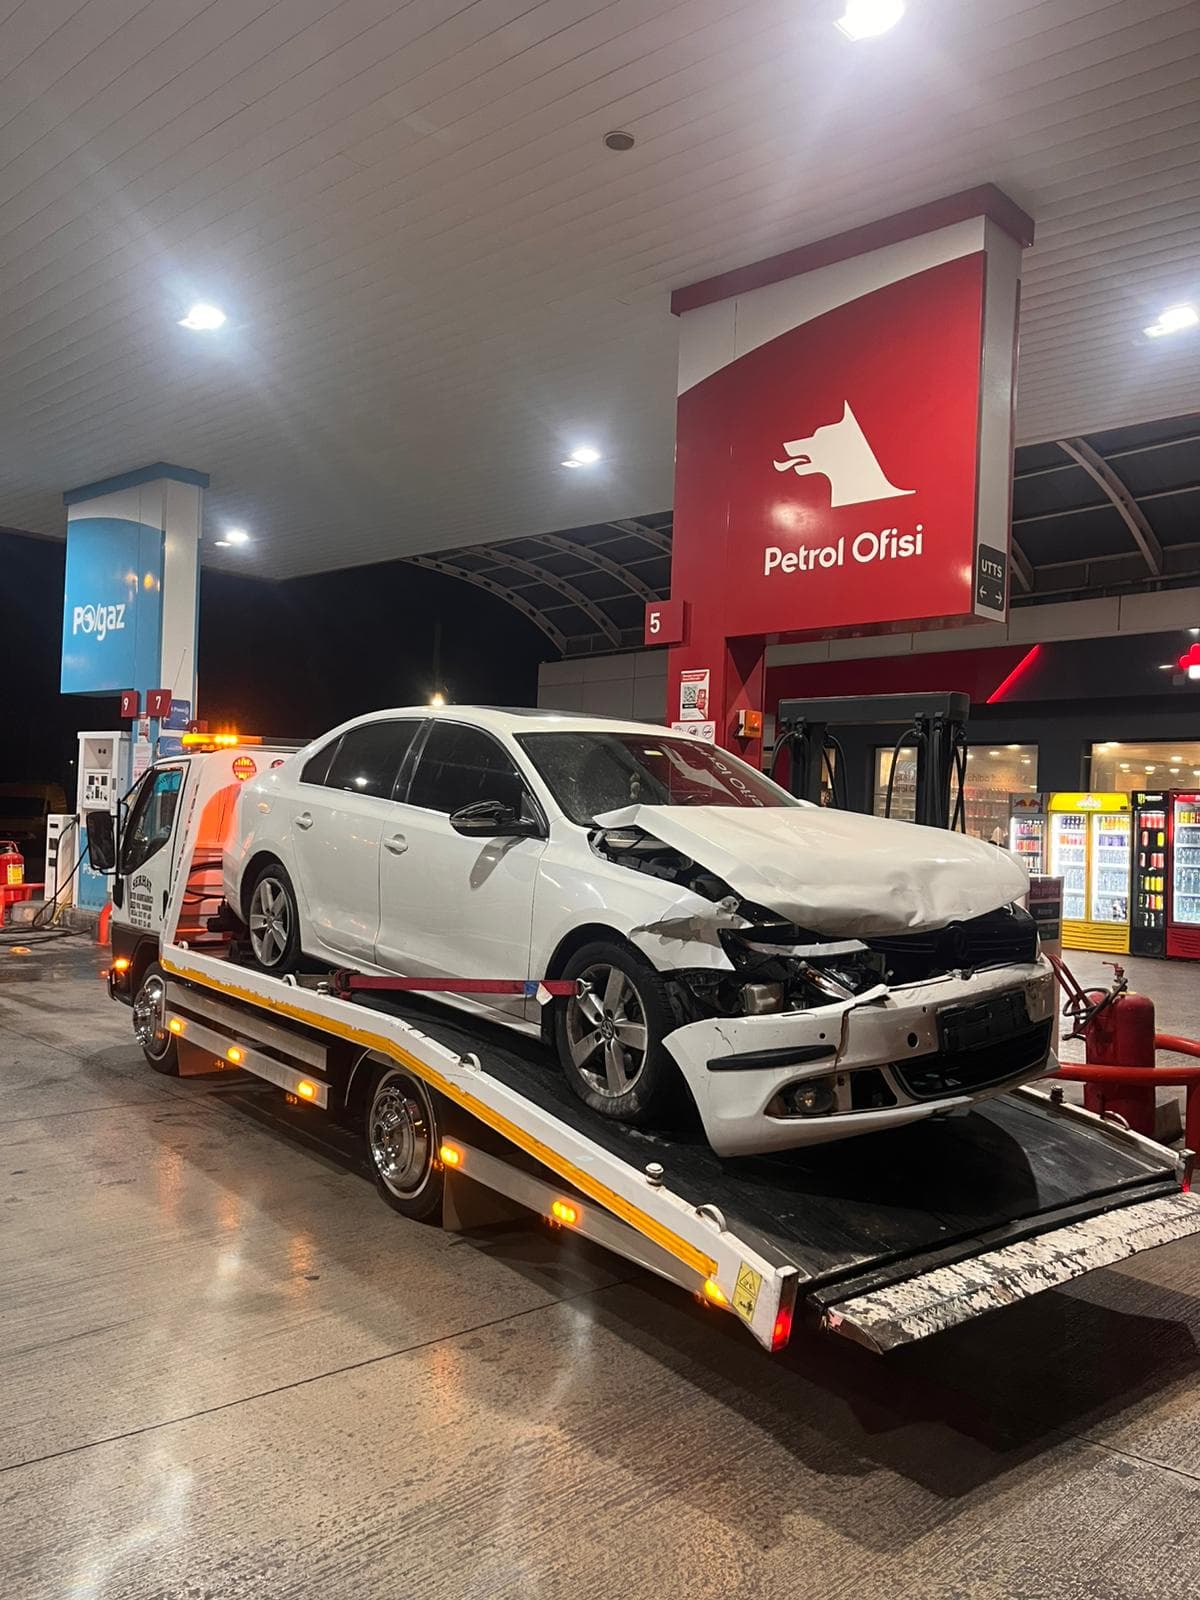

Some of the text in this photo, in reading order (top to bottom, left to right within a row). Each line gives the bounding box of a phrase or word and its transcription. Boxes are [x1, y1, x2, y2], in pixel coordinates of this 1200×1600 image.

[764, 524, 924, 576] Petrol Ofisi
[981, 558, 1003, 578] UTTS
[650, 612, 660, 634] 5
[123, 697, 129, 711] 9
[155, 696, 162, 709] 7
